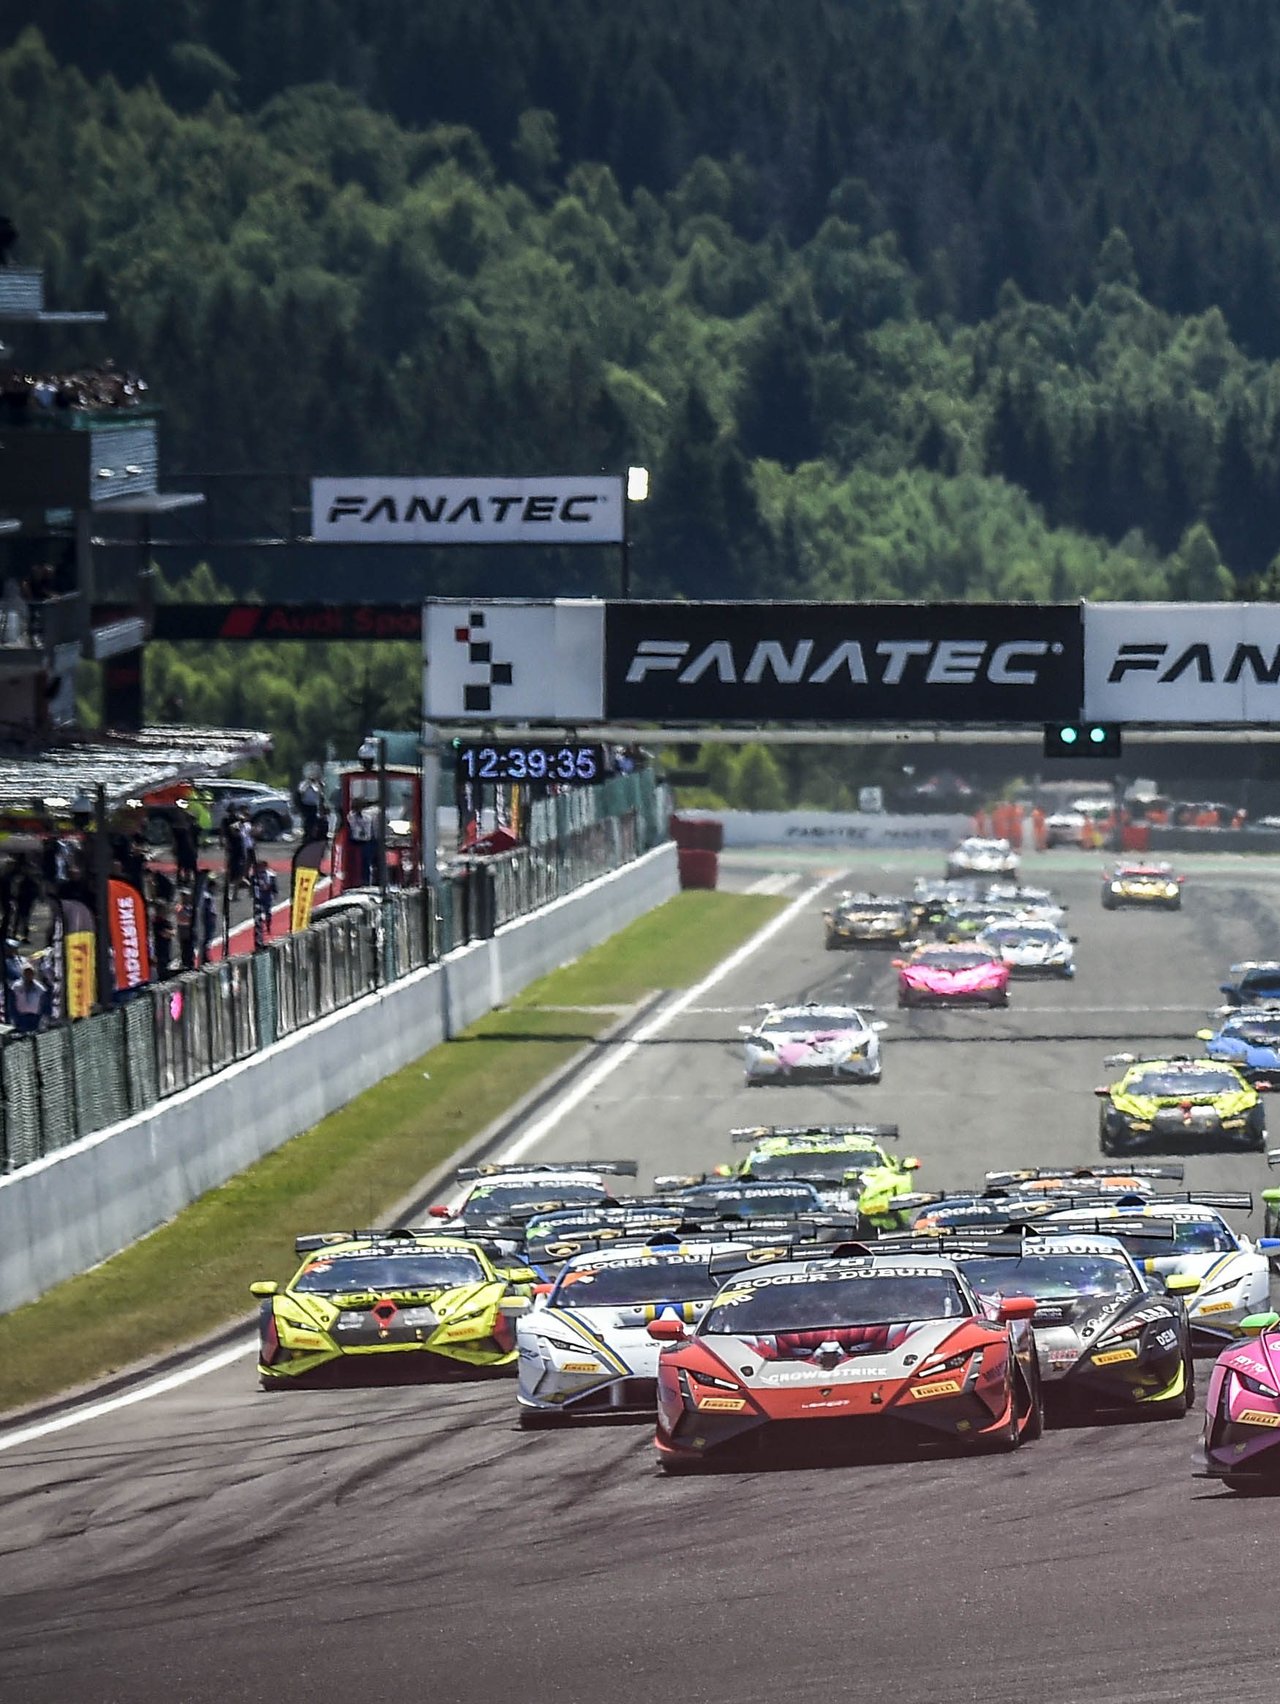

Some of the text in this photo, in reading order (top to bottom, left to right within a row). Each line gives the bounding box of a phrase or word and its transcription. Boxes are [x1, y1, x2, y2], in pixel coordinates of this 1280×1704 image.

[328, 495, 598, 523] FANATEC
[354, 607, 421, 635] Spo
[625, 639, 1048, 684] FANATEC
[461, 747, 597, 779] 12:39:35
[575, 1255, 659, 1272] ROGER
[734, 1267, 943, 1291] ROGER DUBUIS
[1099, 1352, 1133, 1364] PIRELLI
[563, 1363, 598, 1373] PIRELLI
[915, 1383, 956, 1396] PIRELLI
[701, 1398, 742, 1410] PIRELLI
[1241, 1411, 1278, 1425] PIRELLI
